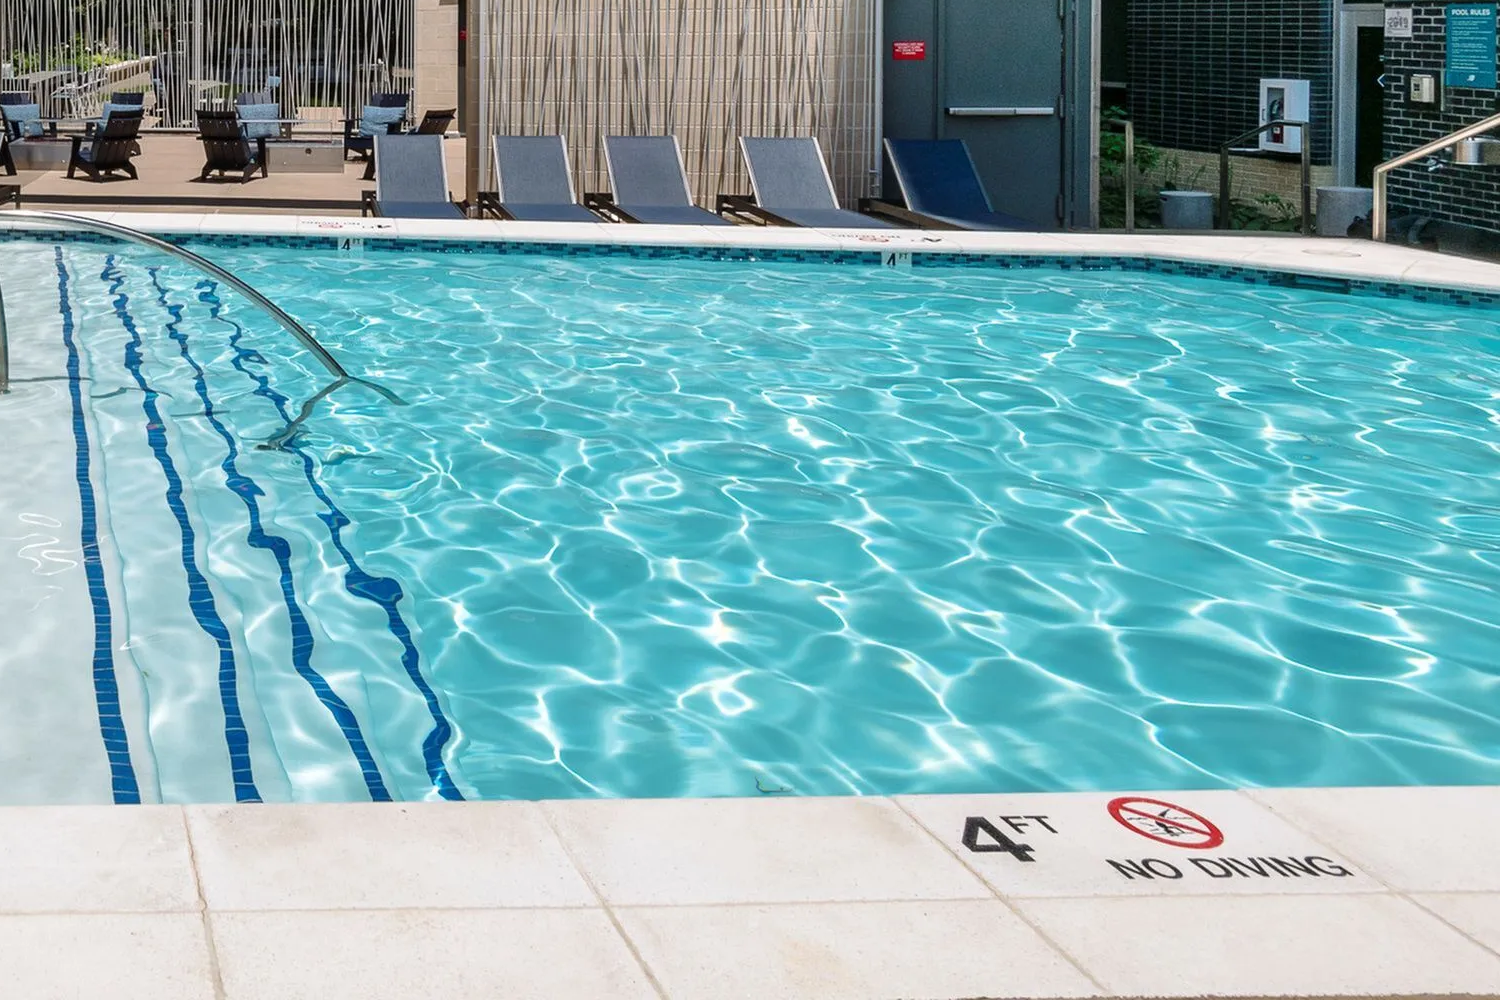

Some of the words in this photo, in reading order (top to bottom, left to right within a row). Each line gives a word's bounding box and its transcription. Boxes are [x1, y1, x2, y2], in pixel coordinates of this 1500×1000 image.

[1451, 8, 1469, 16] POOL
[1470, 8, 1491, 16] RULES
[341, 238, 351, 251] 4
[962, 815, 1037, 862] 4
[1000, 815, 1059, 834] FT
[1105, 858, 1184, 880] NO
[1188, 855, 1355, 878] DIVING
